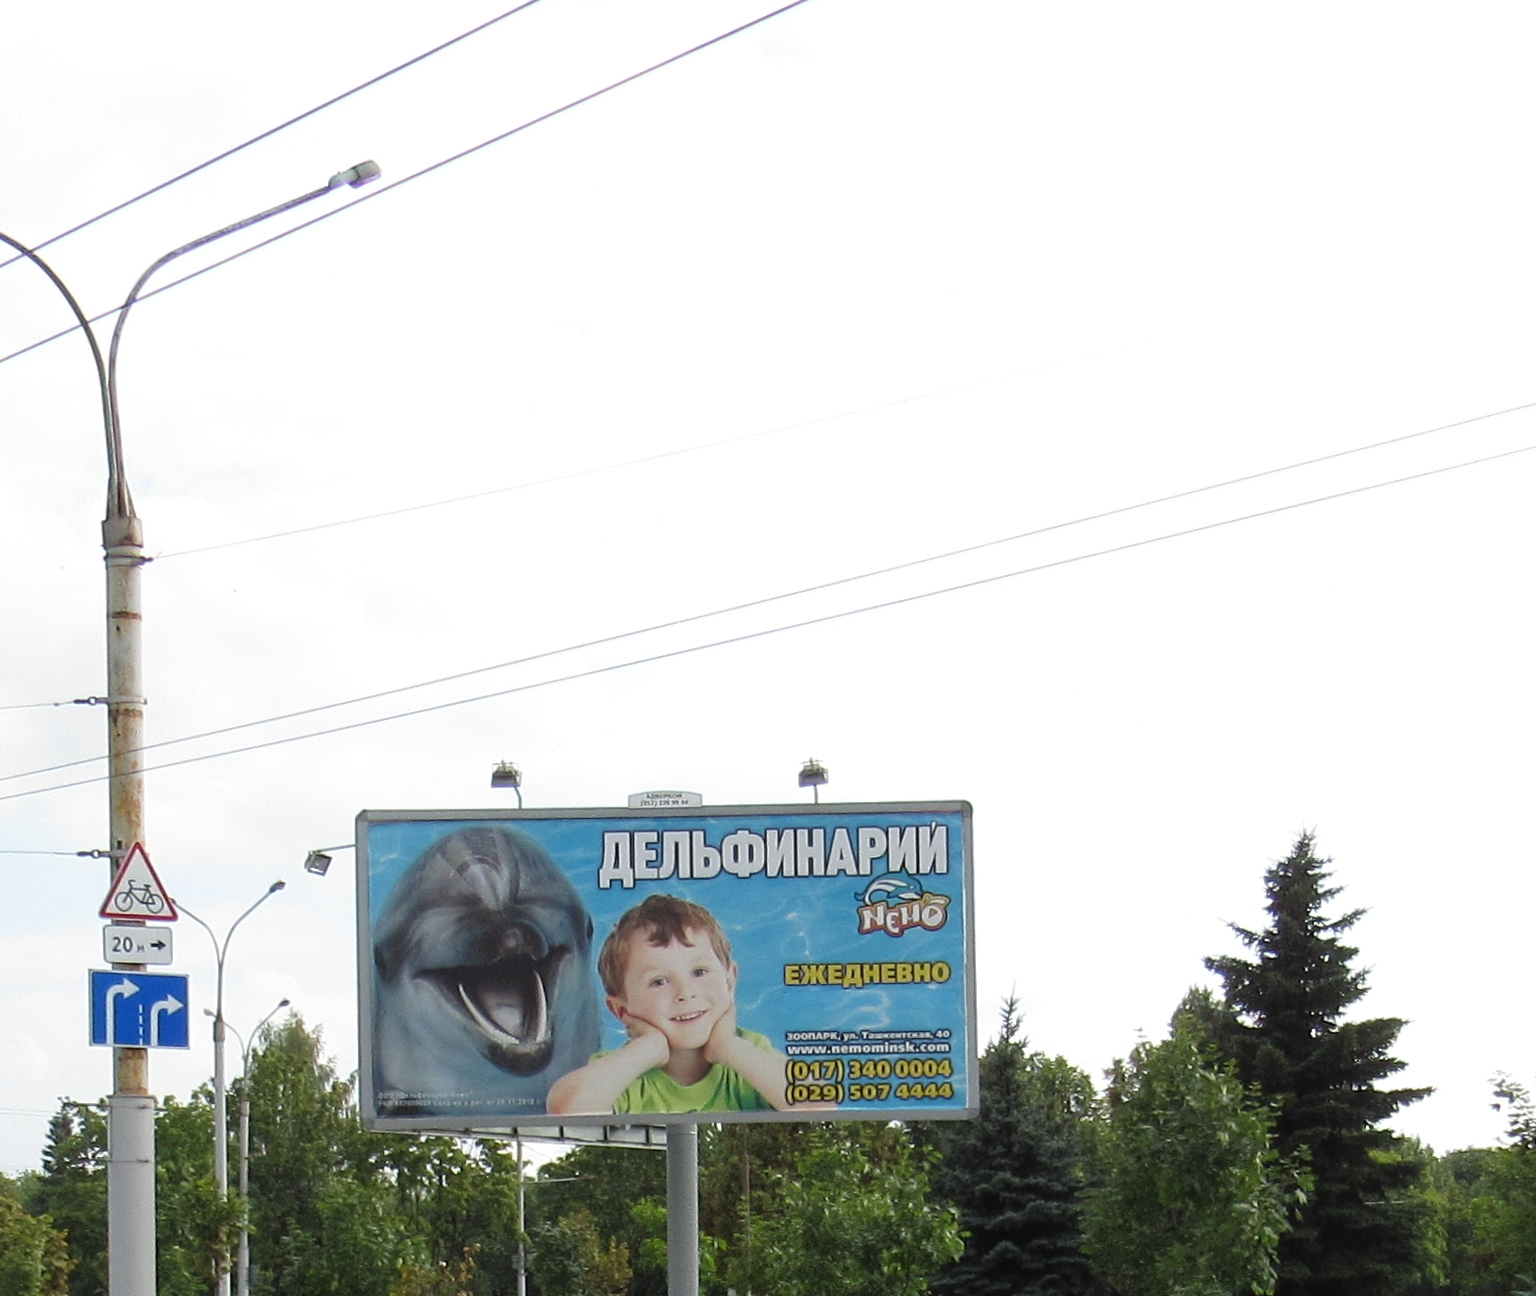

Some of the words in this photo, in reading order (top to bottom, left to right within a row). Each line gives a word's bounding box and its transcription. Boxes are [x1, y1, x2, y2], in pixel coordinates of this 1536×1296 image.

[599, 822, 949, 888] ДЕЛЬФИНАРИЙ
[112, 936, 133, 953] 20
[784, 962, 951, 988] ЕЖЕДНЕВНО
[786, 1031, 841, 1042] ЗООПАРК,
[843, 1033, 859, 1043] ул.
[861, 1030, 934, 1041] Ташкентская,
[936, 1030, 951, 1039] 40
[786, 1041, 950, 1055] www.nemominsk.com
[786, 1059, 845, 1083] (017)
[848, 1059, 892, 1079] 340
[894, 1058, 953, 1079] 0004
[786, 1083, 845, 1105] (029)
[848, 1084, 892, 1101] 507
[895, 1082, 954, 1100] 4444
